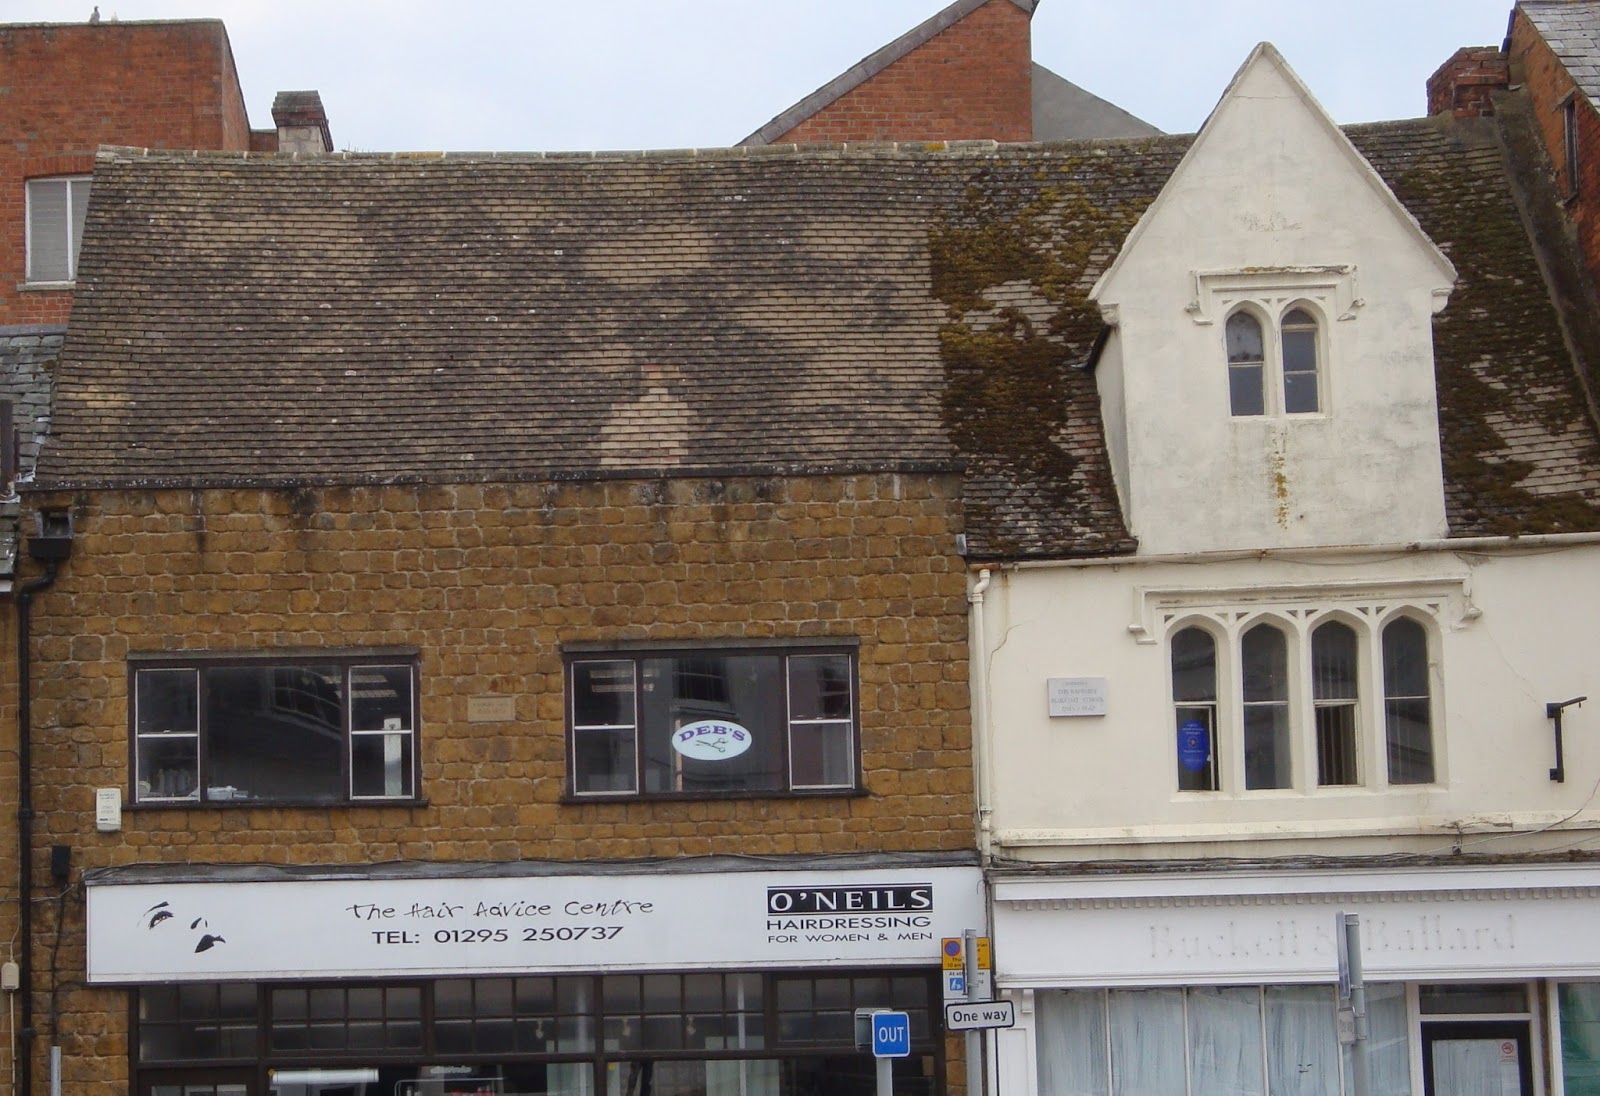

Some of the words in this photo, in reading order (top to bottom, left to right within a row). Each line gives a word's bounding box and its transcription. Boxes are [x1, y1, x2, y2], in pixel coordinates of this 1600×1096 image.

[679, 725, 746, 742] DEB'S
[770, 889, 931, 911] O'NEILS
[345, 903, 396, 921] The
[404, 902, 464, 919] Hair
[473, 901, 551, 918] Advice
[564, 899, 653, 916] Centre
[767, 916, 932, 931] HAIRDRESSING
[372, 930, 420, 944] TEL:
[434, 929, 508, 943] 01295
[522, 926, 624, 942] 250737
[768, 935, 798, 943] FOR
[805, 933, 870, 942] WOMEN
[877, 933, 888, 941] &
[897, 932, 933, 941] MEN
[953, 1010, 978, 1023] One
[983, 1009, 1008, 1022] way
[878, 1027, 904, 1043] OUT
